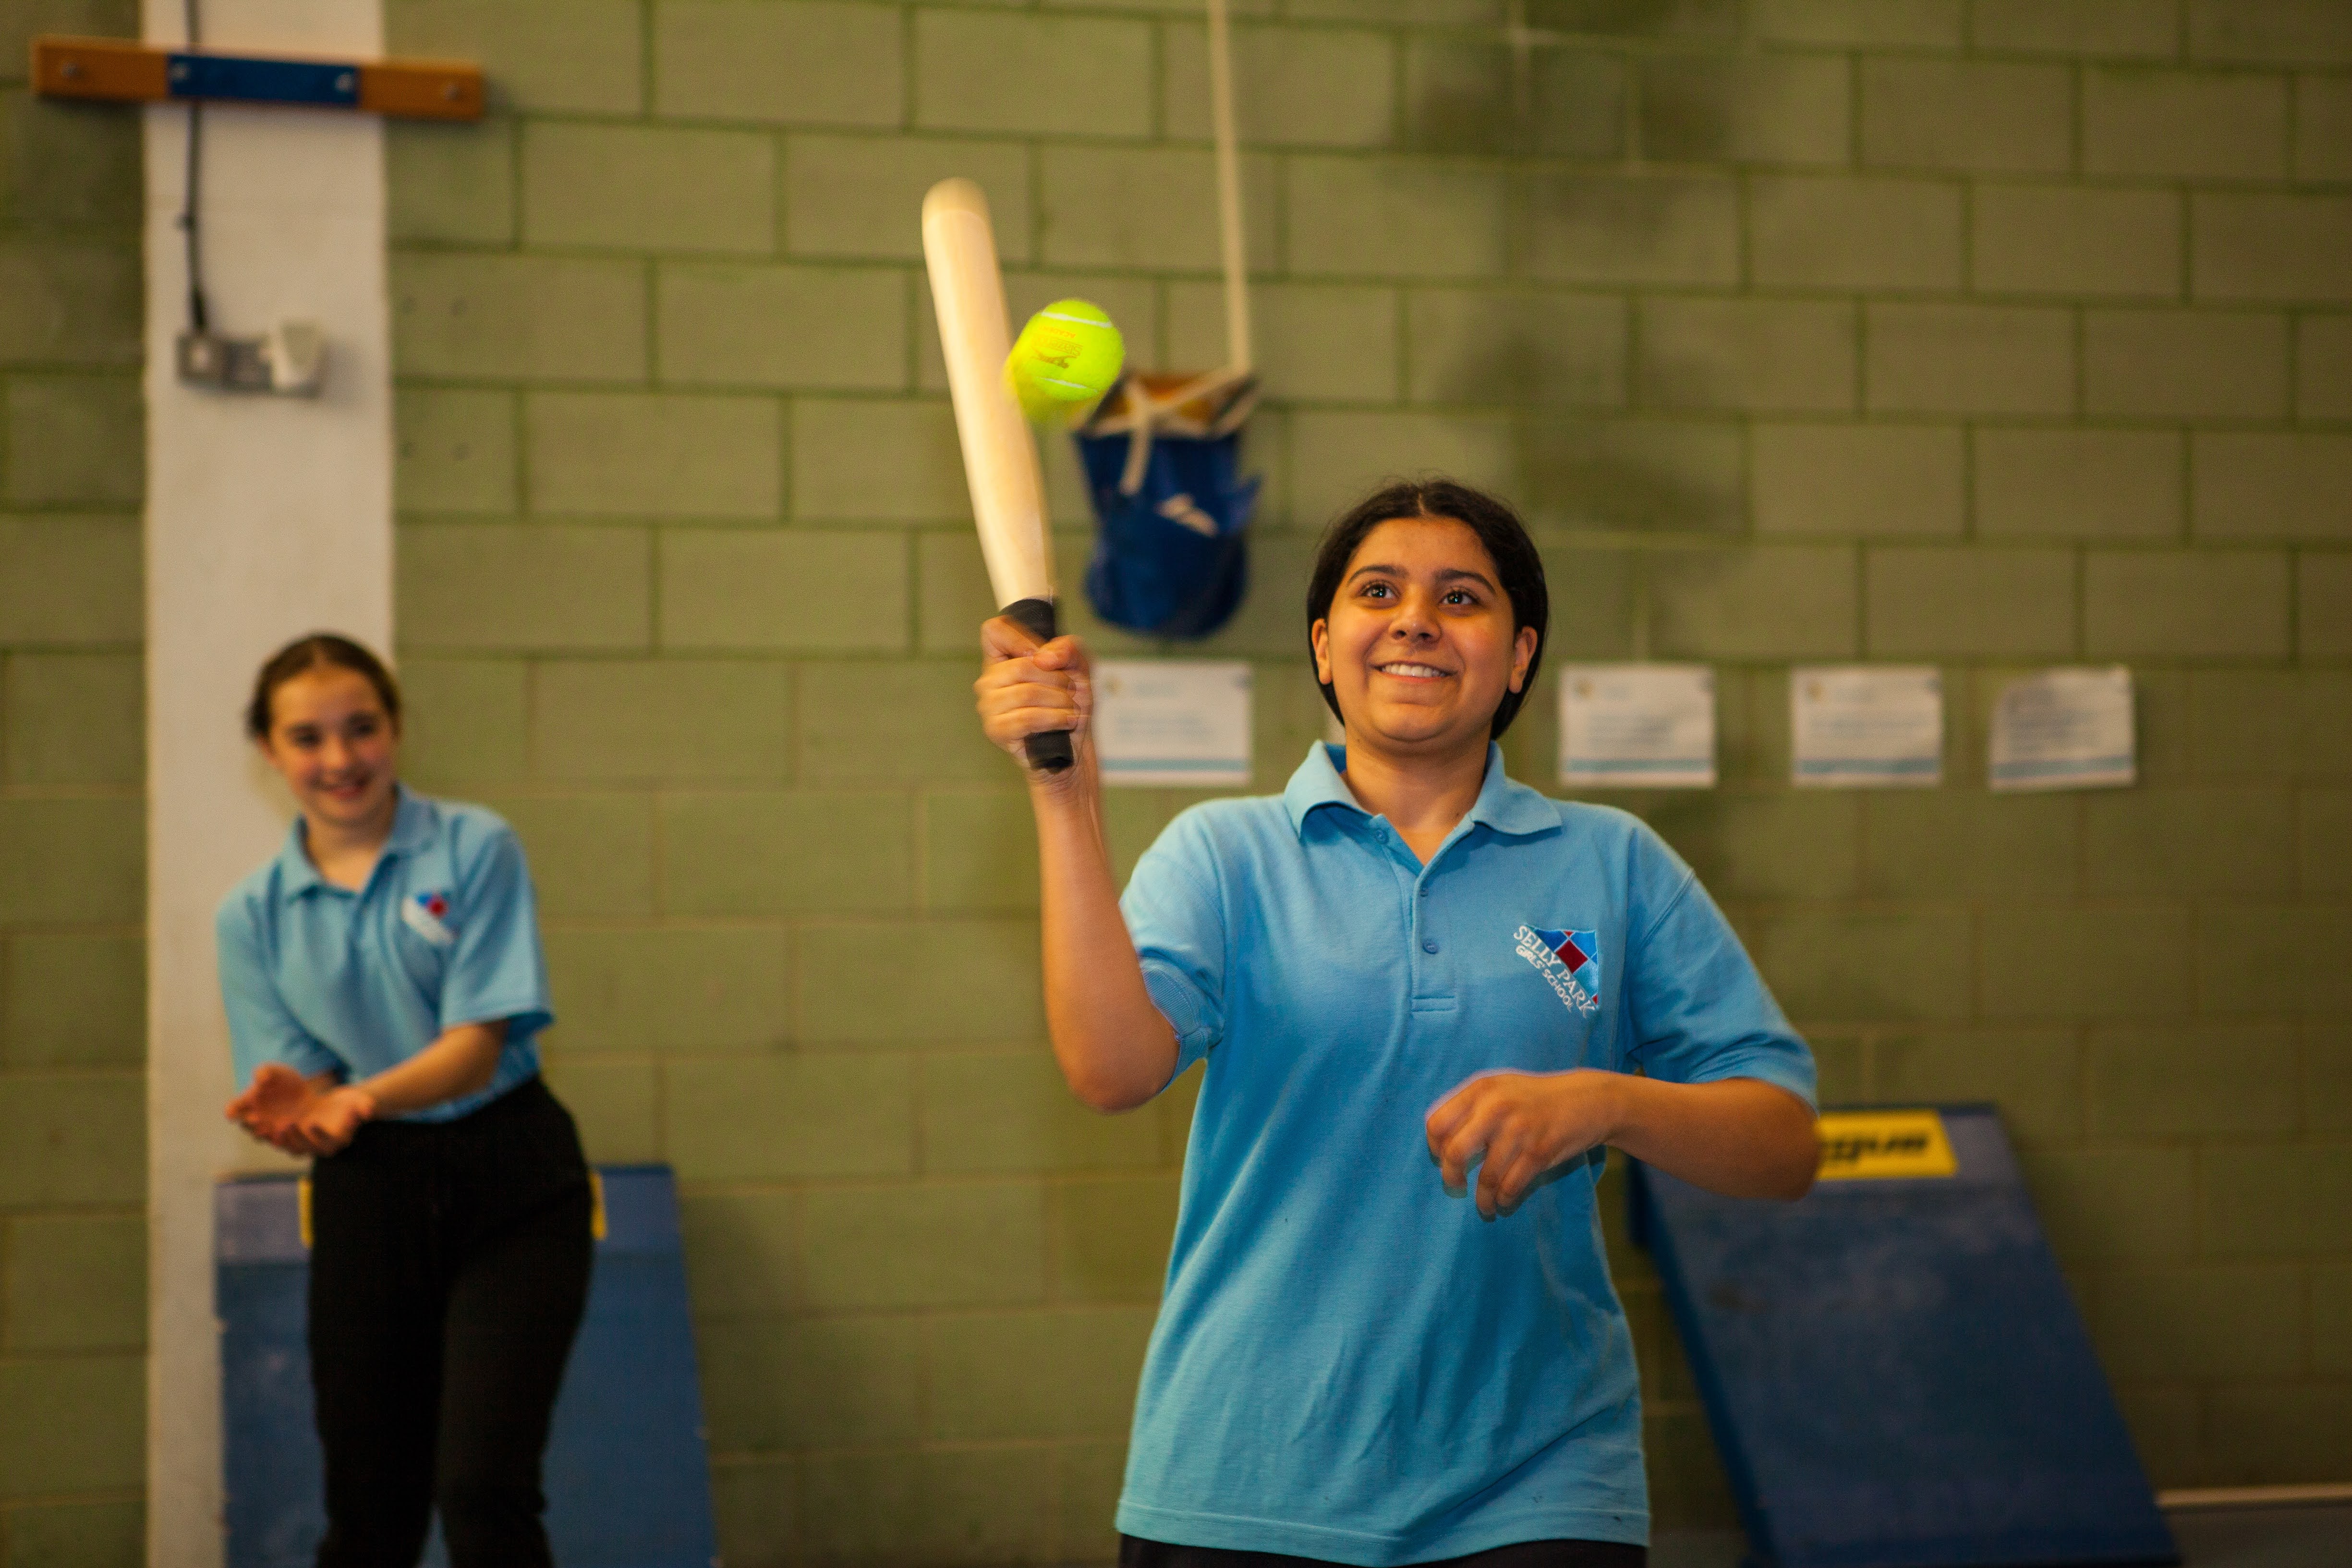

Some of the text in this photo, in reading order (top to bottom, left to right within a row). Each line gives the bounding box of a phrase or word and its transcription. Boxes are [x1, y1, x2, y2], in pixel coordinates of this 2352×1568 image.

[1031, 334, 1082, 356] Slazen
[1513, 925, 1595, 1019] SELLY PARK
[1542, 968, 1574, 1013] SCHOOL
